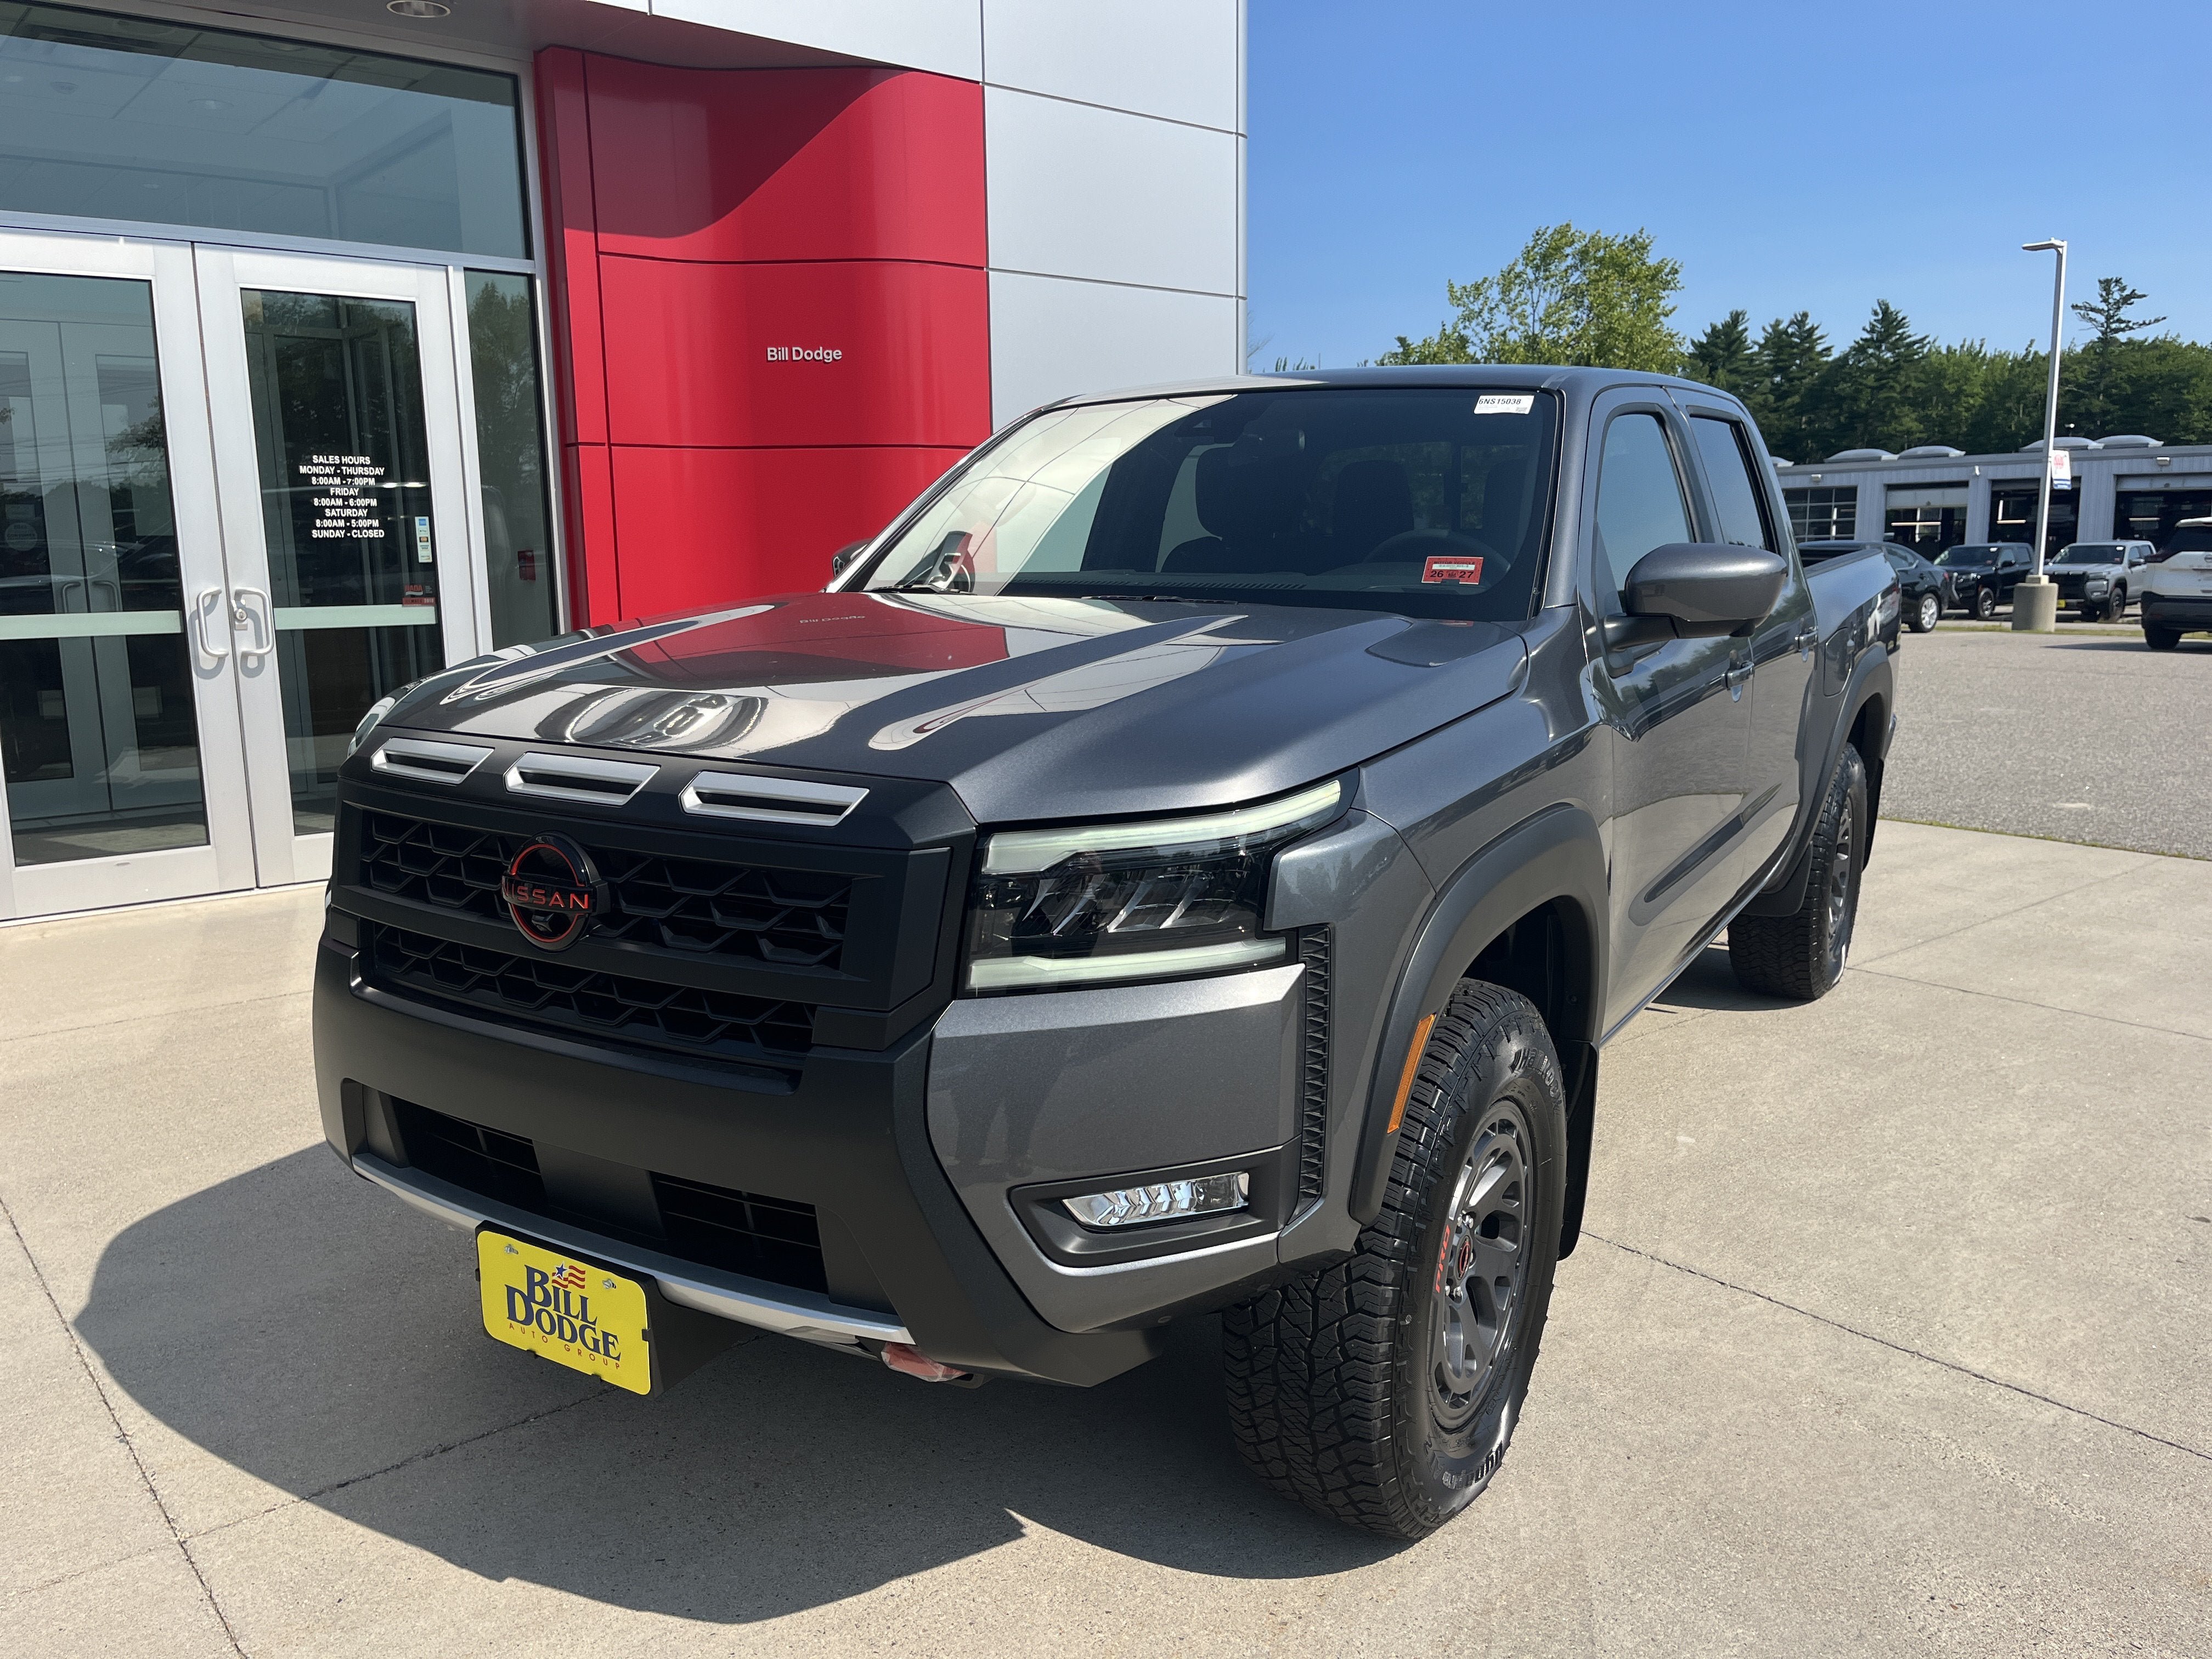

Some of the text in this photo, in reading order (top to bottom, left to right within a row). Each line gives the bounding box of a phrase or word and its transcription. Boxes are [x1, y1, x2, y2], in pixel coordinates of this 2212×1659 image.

[768, 346, 843, 363] Bill Dodge
[313, 455, 371, 465] SALES HOURS
[300, 465, 335, 474] MONDAY
[341, 466, 385, 475] THURSDAY
[312, 476, 341, 485] 8:00AM
[347, 477, 375, 486] 7:00PM
[330, 487, 359, 496] FRIDAY
[314, 498, 343, 506] 8:00AM
[349, 498, 377, 506] 6:00PM
[325, 509, 368, 517] SATURDAY
[315, 519, 345, 527] 8:00AM
[351, 519, 379, 527] 5:00PM
[312, 529, 345, 538] SUNDAY
[352, 529, 385, 538] CLOSED
[501, 880, 589, 910] NISSAN
[1435, 1224, 1451, 1294] PRO
[524, 1264, 598, 1326] BILL
[504, 1284, 621, 1362] DODGE
[509, 1322, 620, 1370] AUTO GROUP
